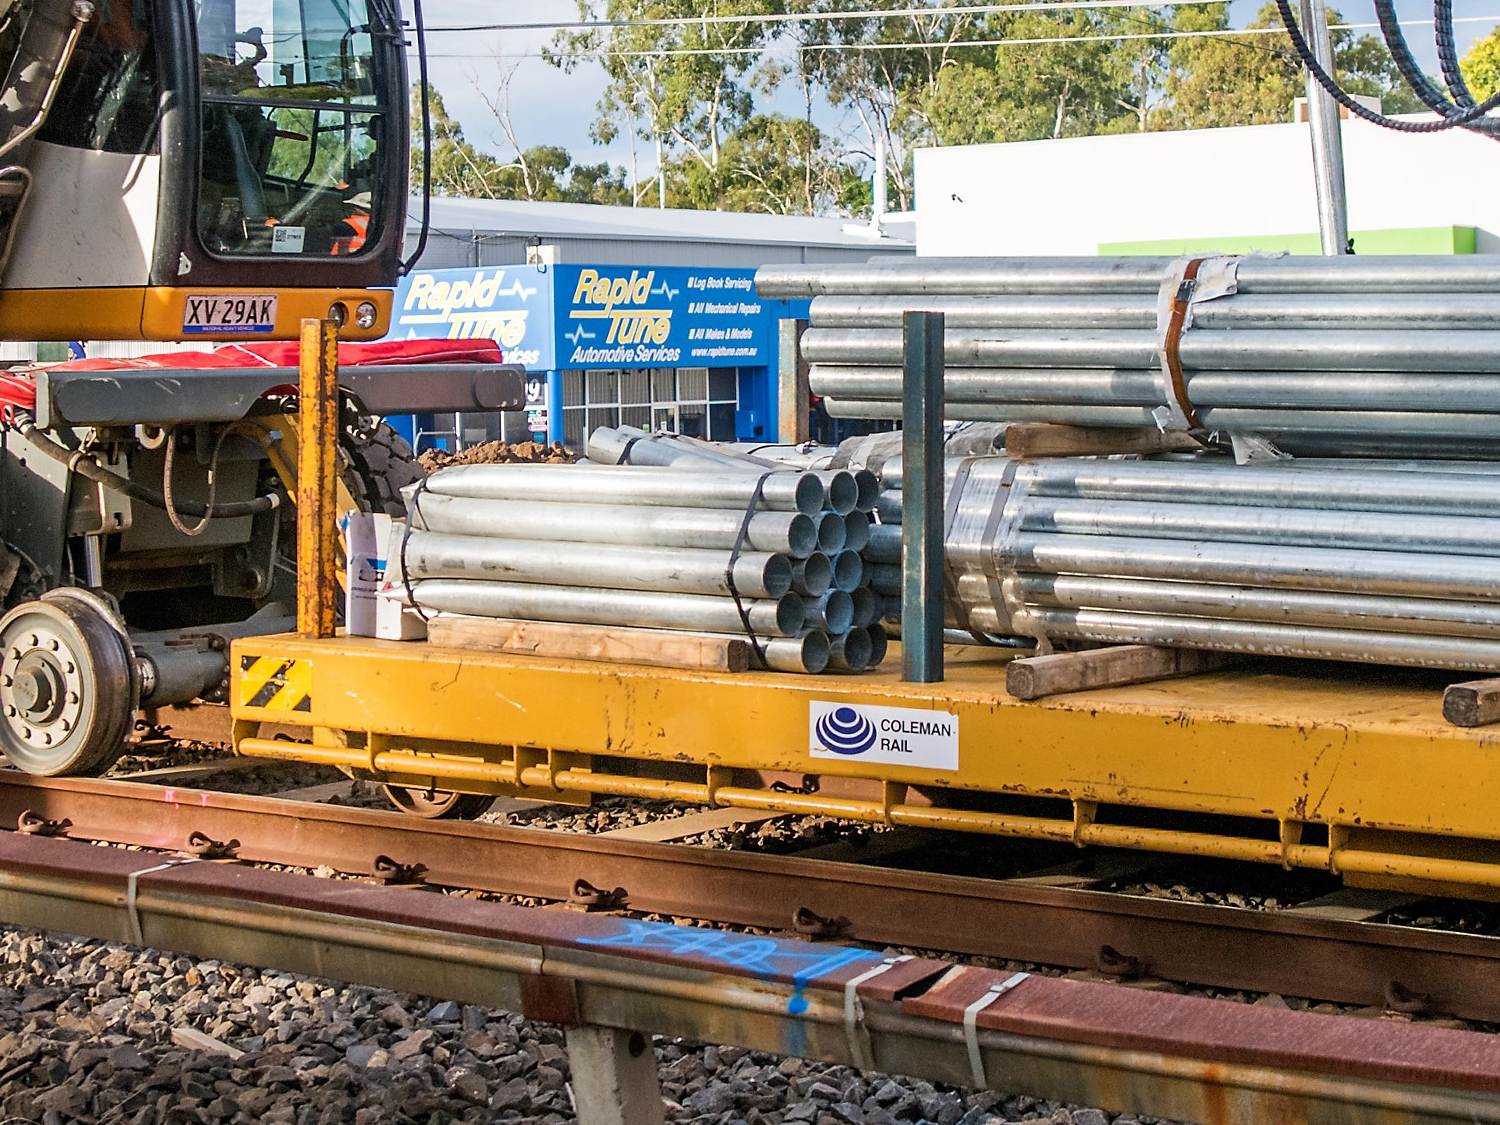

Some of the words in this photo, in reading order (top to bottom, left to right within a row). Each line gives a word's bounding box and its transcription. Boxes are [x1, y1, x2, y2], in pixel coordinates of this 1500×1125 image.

[571, 269, 655, 317] Rapid
[693, 276, 706, 291] Log
[707, 276, 724, 288] Book
[724, 276, 752, 292] Servicing
[402, 270, 505, 322] Rapid
[187, 300, 218, 324] XV
[221, 299, 273, 324] 29AK
[694, 302, 705, 314] All
[705, 302, 739, 314] Mechanical
[739, 302, 761, 316] Repairs
[447, 310, 529, 348] Tune
[605, 309, 673, 345] Tune
[695, 328, 705, 340] All
[705, 328, 725, 340] Makes
[725, 328, 730, 340] &
[730, 328, 753, 340] Models
[502, 347, 540, 365] vices
[569, 345, 634, 364] Automotive
[635, 344, 681, 363] Services
[691, 346, 757, 359] www.rapidtune.com.au
[880, 719, 951, 737] COLEMAN
[880, 738, 912, 753] RAIL
